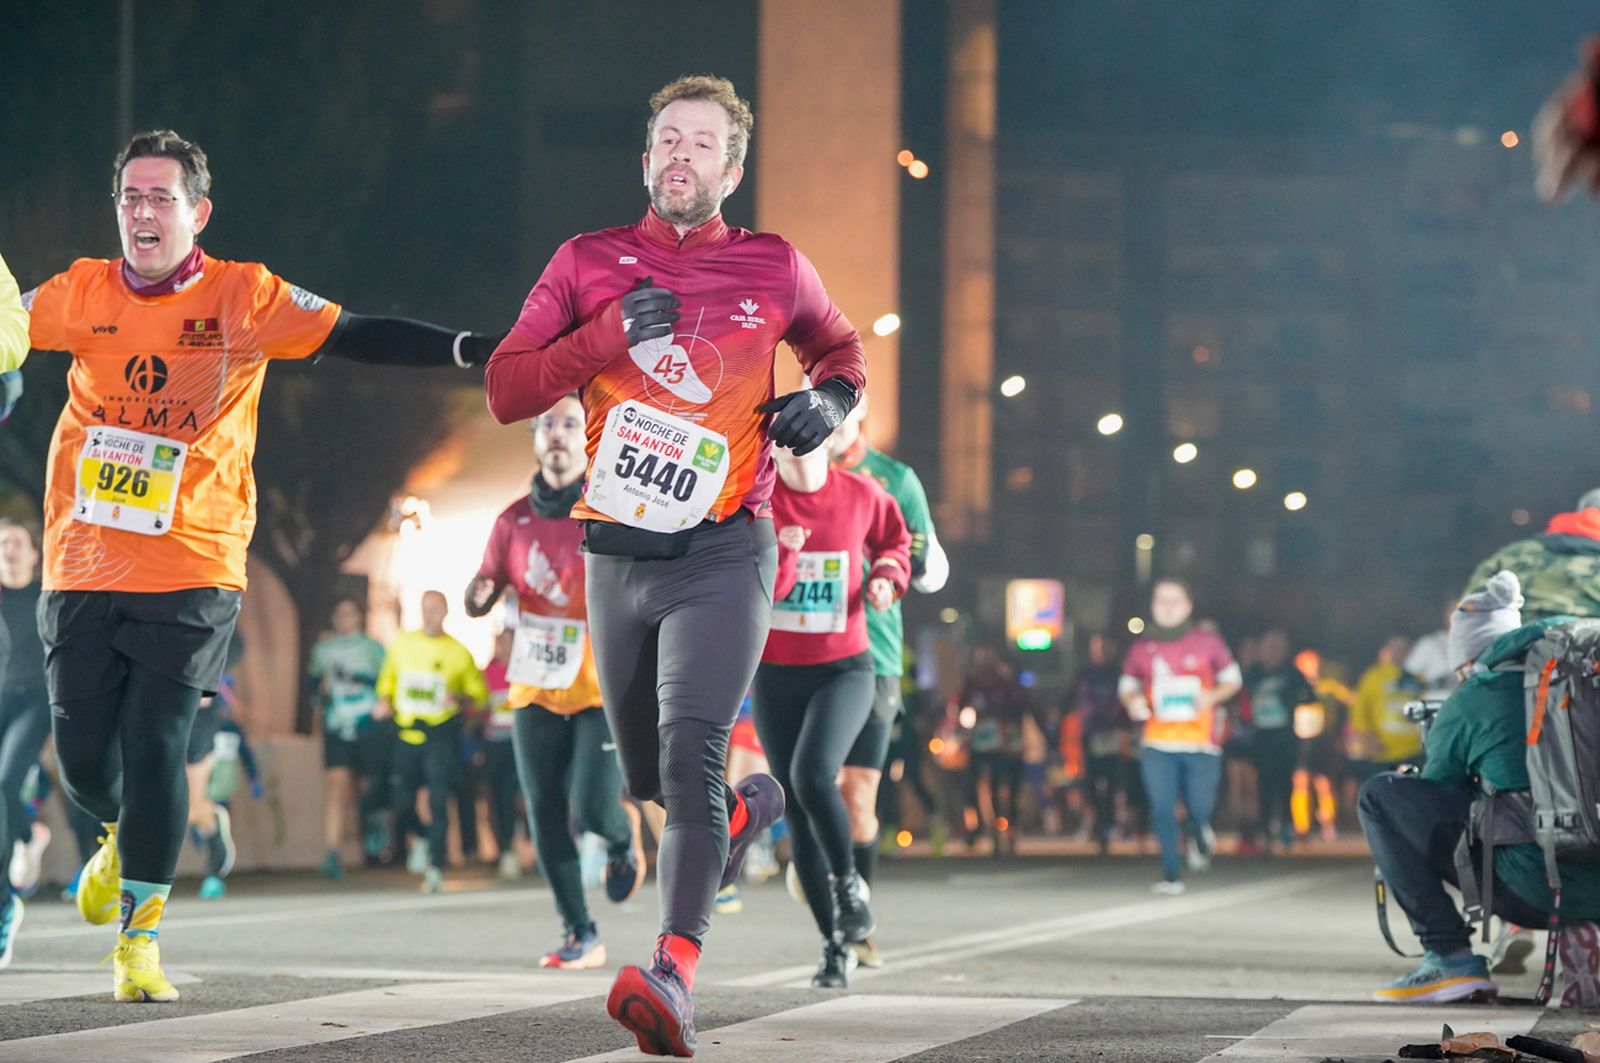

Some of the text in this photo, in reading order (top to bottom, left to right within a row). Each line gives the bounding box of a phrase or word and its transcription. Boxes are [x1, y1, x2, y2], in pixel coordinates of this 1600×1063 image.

[653, 354, 687, 385] 43
[91, 404, 198, 432] ALMA
[634, 417, 673, 440] NOCHE
[672, 432, 689, 446] DE
[132, 443, 145, 454] DE
[616, 425, 684, 460] SAN ANTÓN
[97, 462, 150, 498] 926
[614, 443, 698, 503] 5440
[623, 484, 651, 500] Antonio
